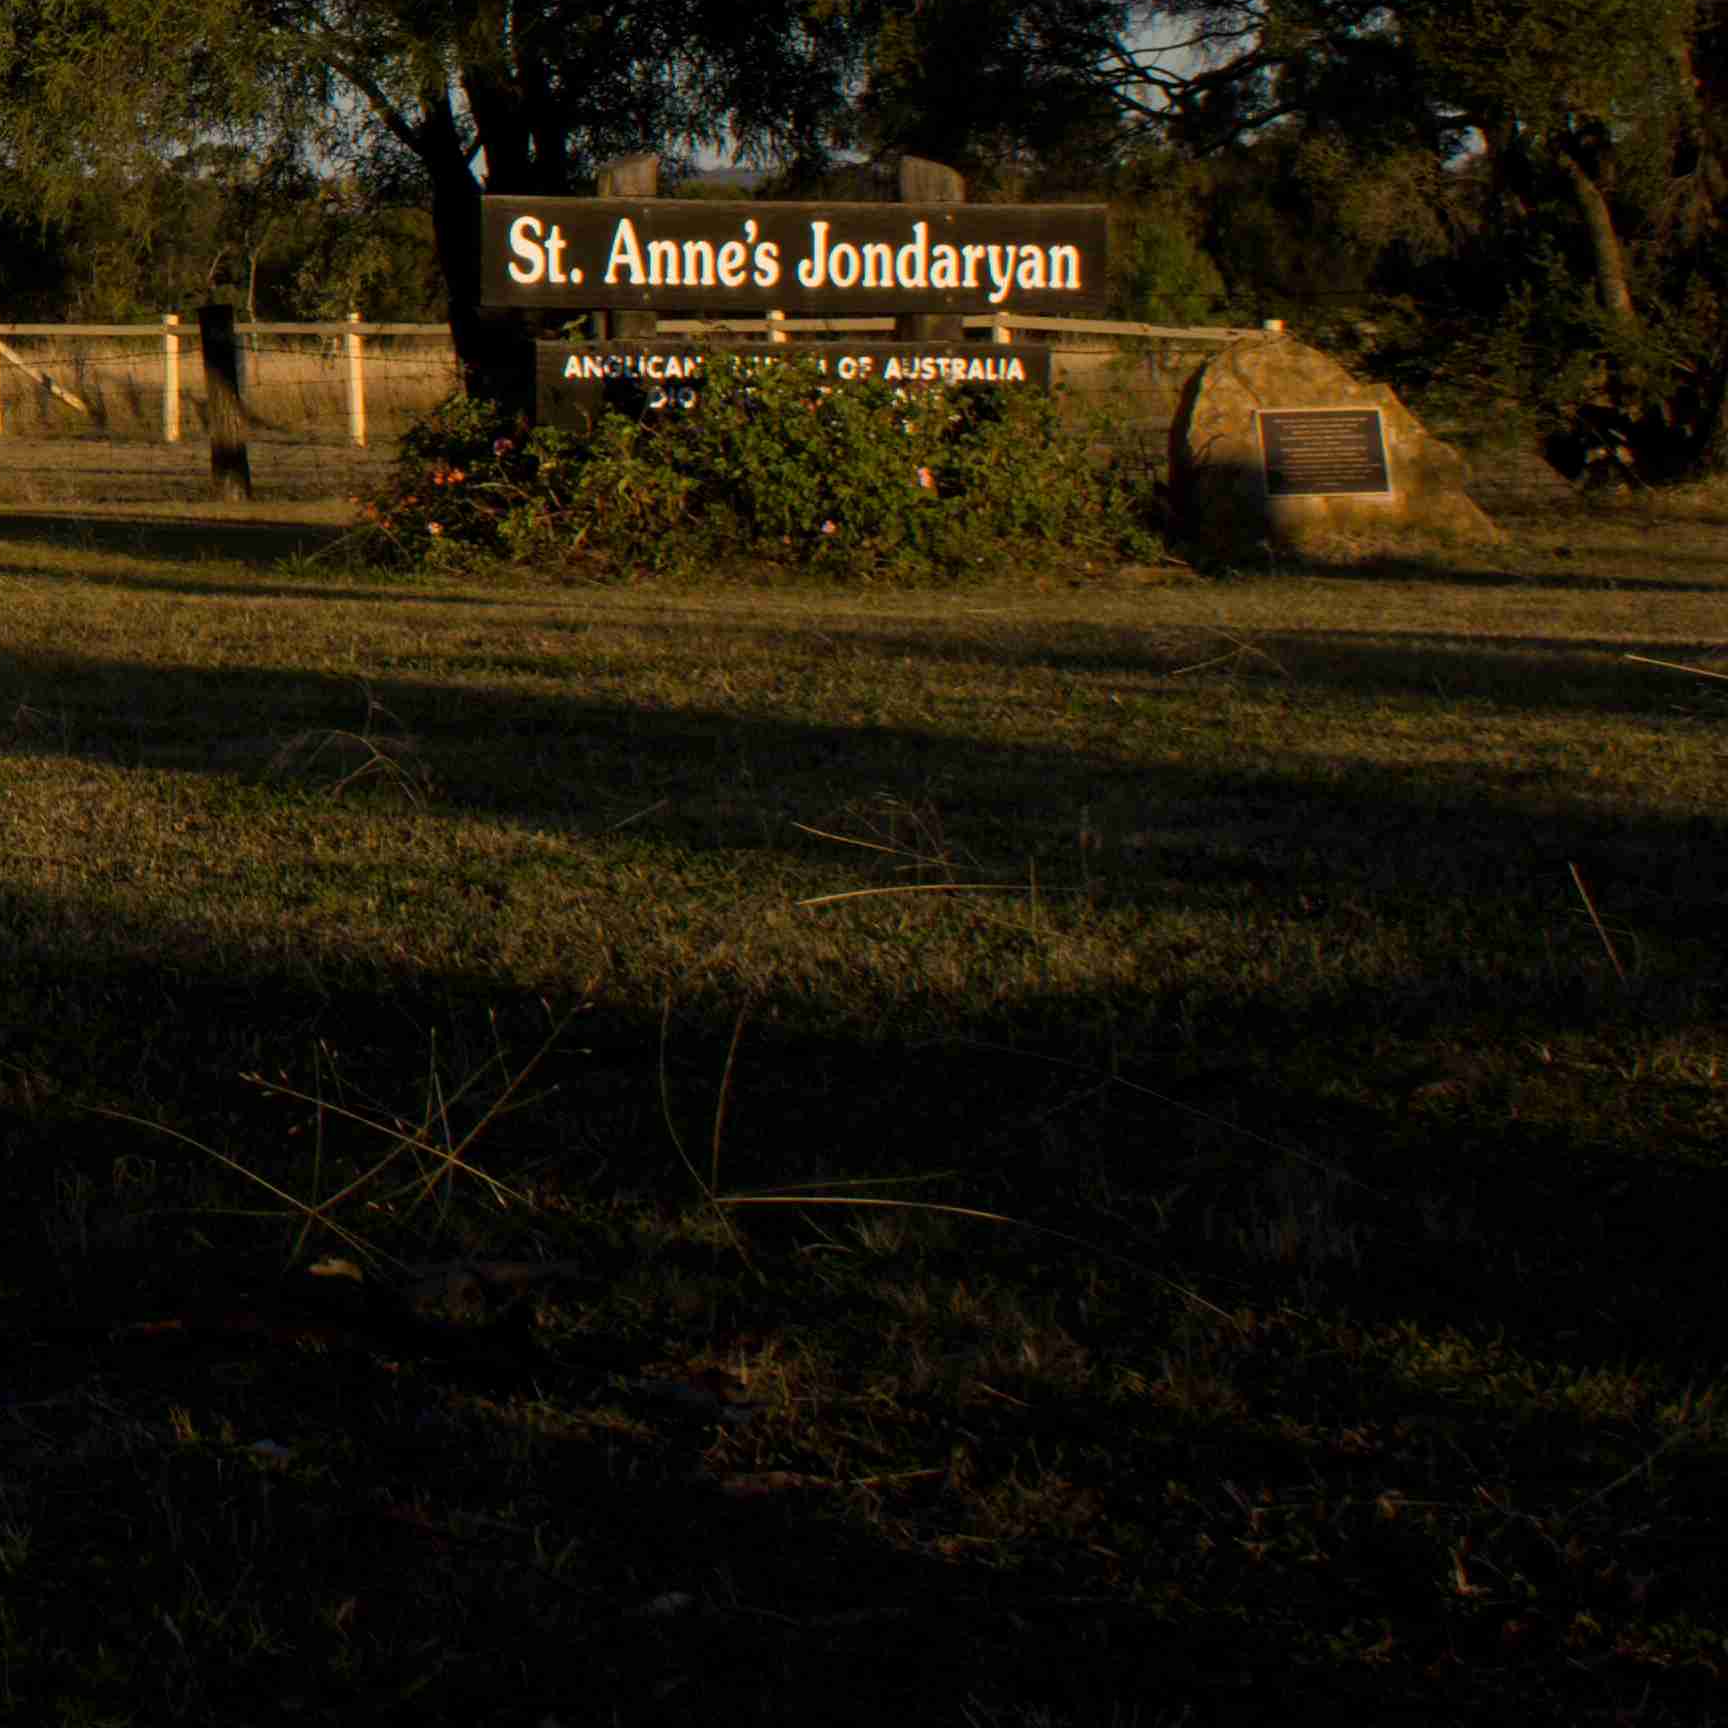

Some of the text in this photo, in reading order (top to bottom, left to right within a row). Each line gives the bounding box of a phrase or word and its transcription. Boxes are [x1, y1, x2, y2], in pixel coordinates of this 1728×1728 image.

[507, 215, 1082, 303] St. Anne's Jondaryan
[838, 355, 873, 380] OF
[884, 355, 1026, 381] AUSTRALIA
